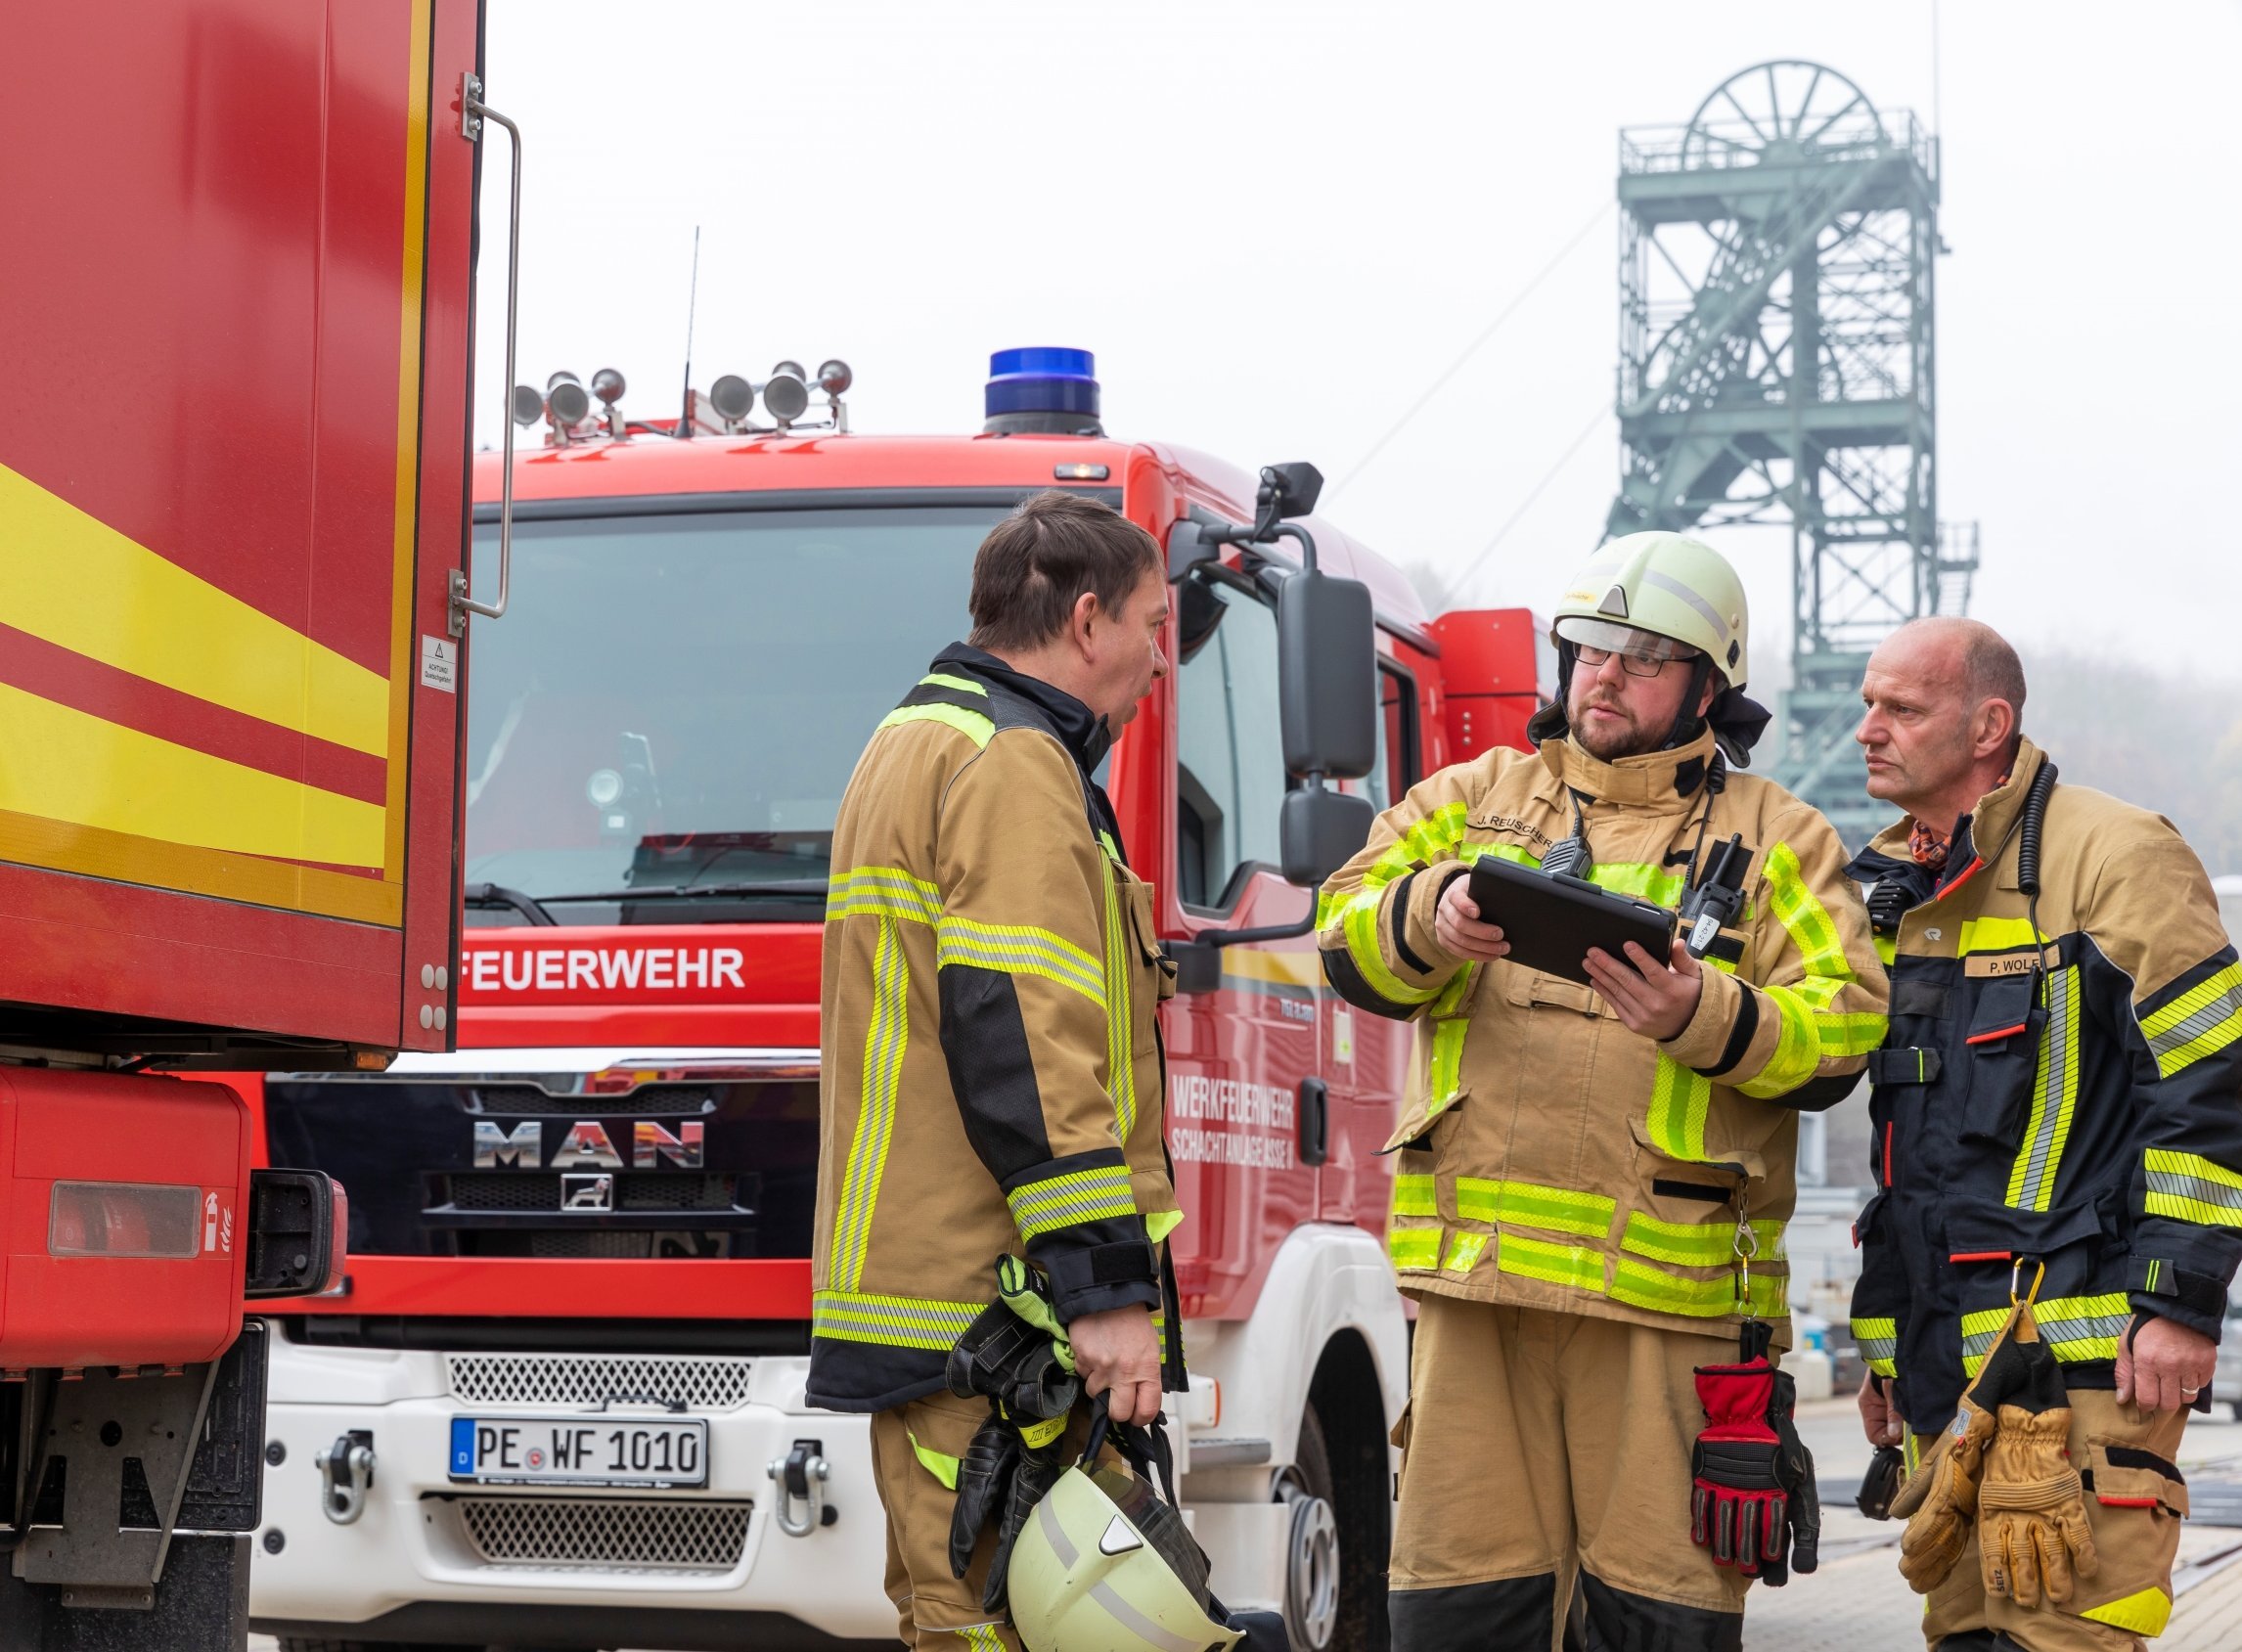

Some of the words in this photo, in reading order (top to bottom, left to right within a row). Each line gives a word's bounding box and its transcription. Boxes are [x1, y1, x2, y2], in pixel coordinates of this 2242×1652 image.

[1477, 816, 1486, 826] J.
[1490, 815, 1553, 848] REUSCHER
[1173, 1074, 1294, 1130] WERKFEUERWEHR
[473, 1121, 704, 1168] MAN
[458, 1451, 469, 1465] D
[477, 1427, 520, 1468] PE
[552, 1429, 596, 1470] WF
[608, 1431, 697, 1472] 1010
[1994, 1568, 2005, 1592] SEIZ
